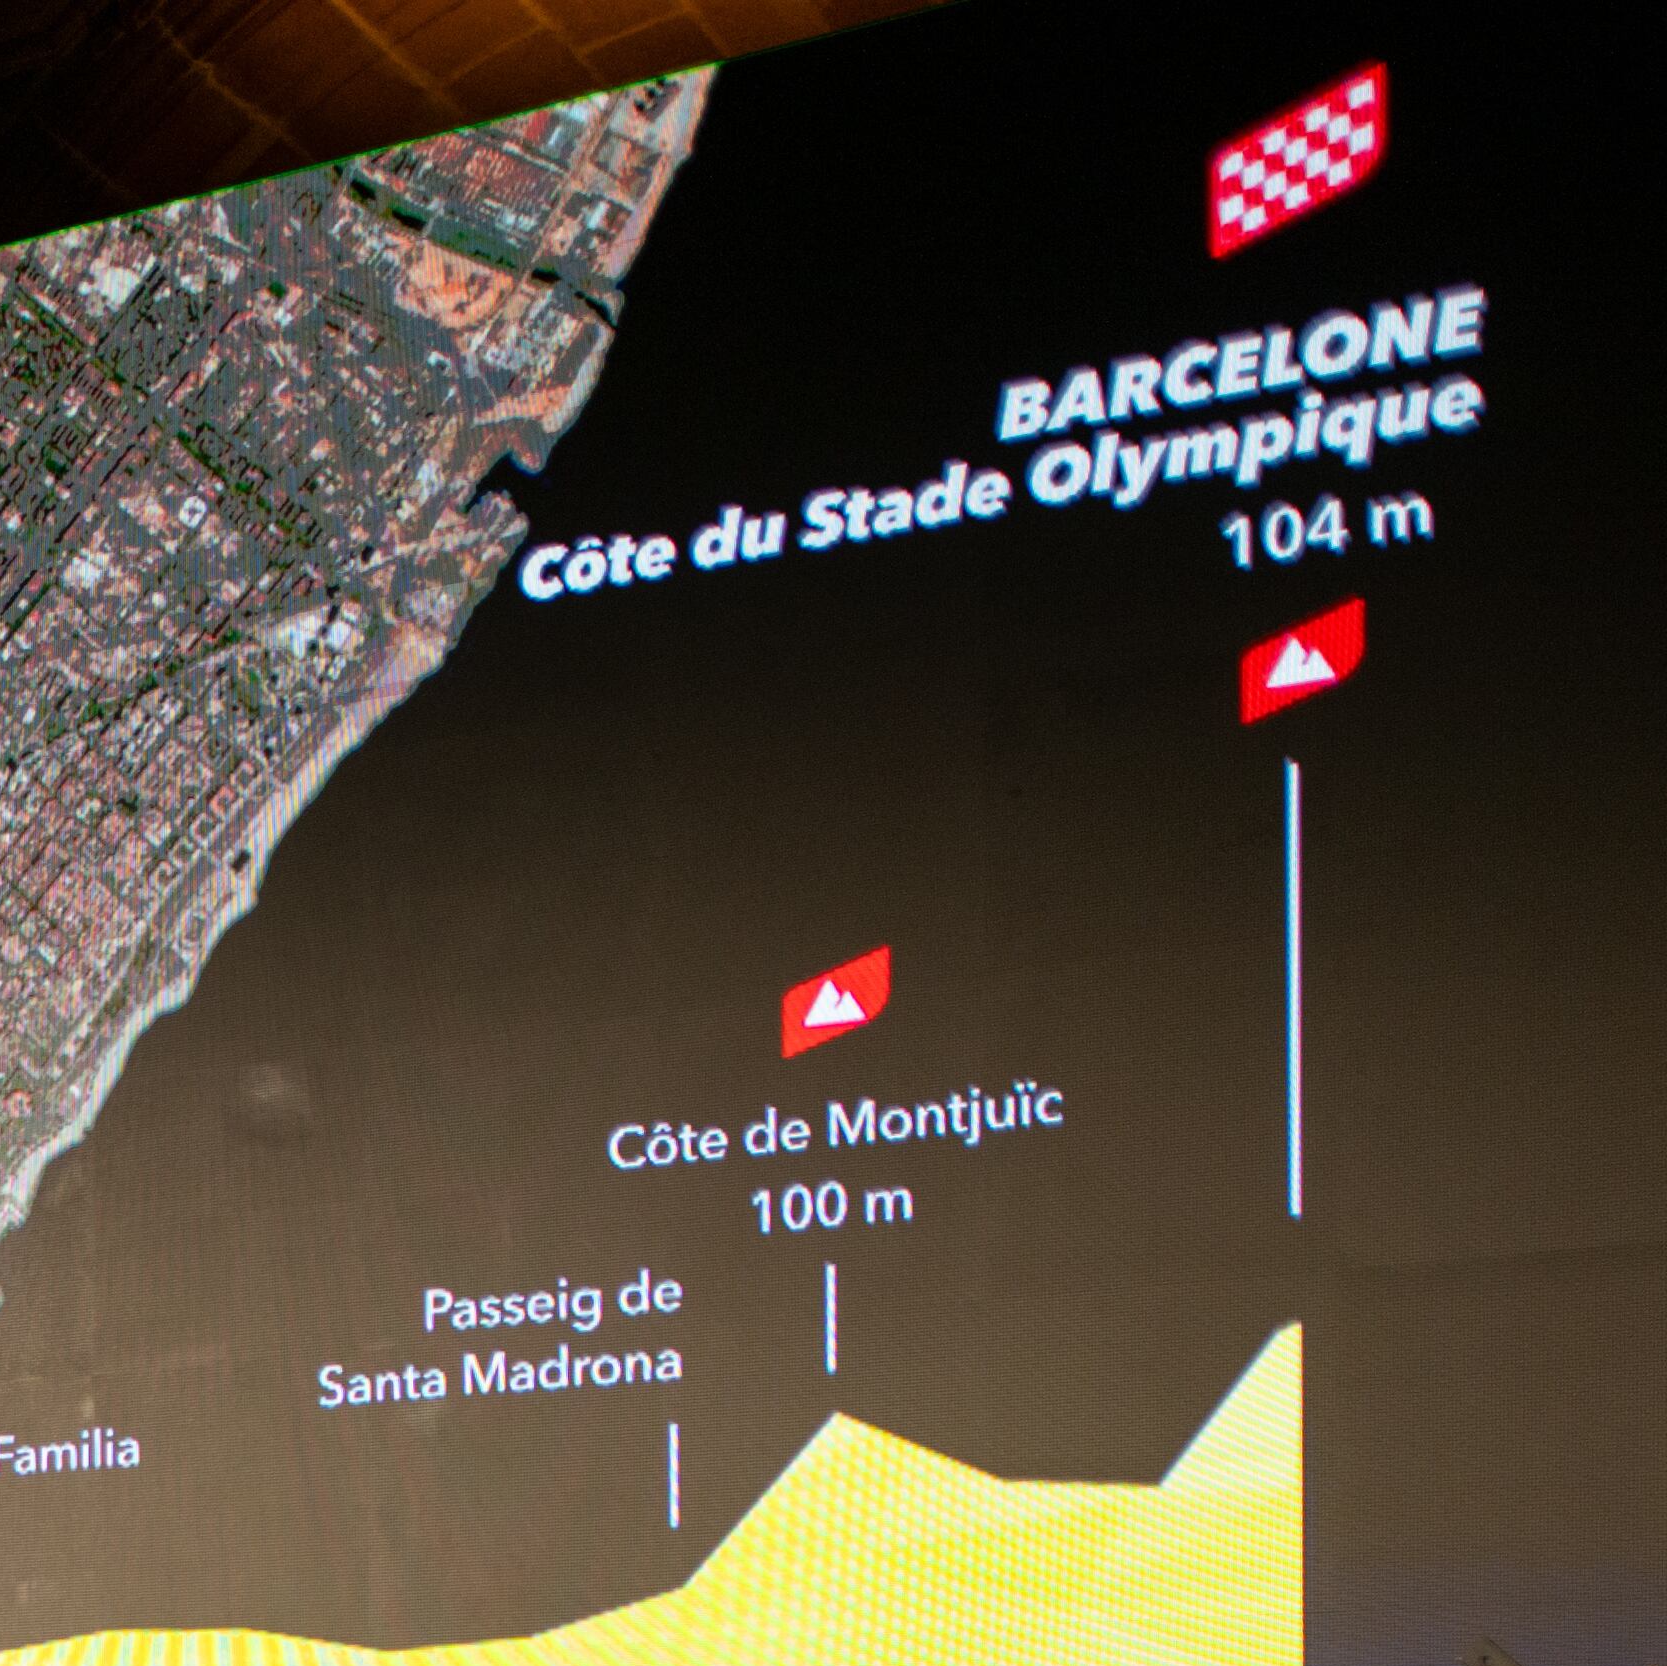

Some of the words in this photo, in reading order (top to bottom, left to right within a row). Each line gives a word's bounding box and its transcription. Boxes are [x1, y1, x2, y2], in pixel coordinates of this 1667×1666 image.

[998, 285, 1485, 441] BARCELONE
[519, 527, 675, 601] Côte
[690, 506, 786, 573] du
[802, 459, 1011, 553] Stade
[1028, 373, 1484, 508] Olympique
[1222, 497, 1348, 570] 104
[1369, 493, 1433, 546] m
[607, 1123, 728, 1170] Côte
[744, 1107, 811, 1155] de
[827, 1080, 1064, 1148] Montjuïc
[751, 1181, 848, 1233] 100
[865, 1185, 913, 1225] m
[423, 1278, 602, 1332] Passeig
[618, 1268, 683, 1314] de
[319, 1355, 447, 1407] Santa
[462, 1344, 683, 1397] Madrona
